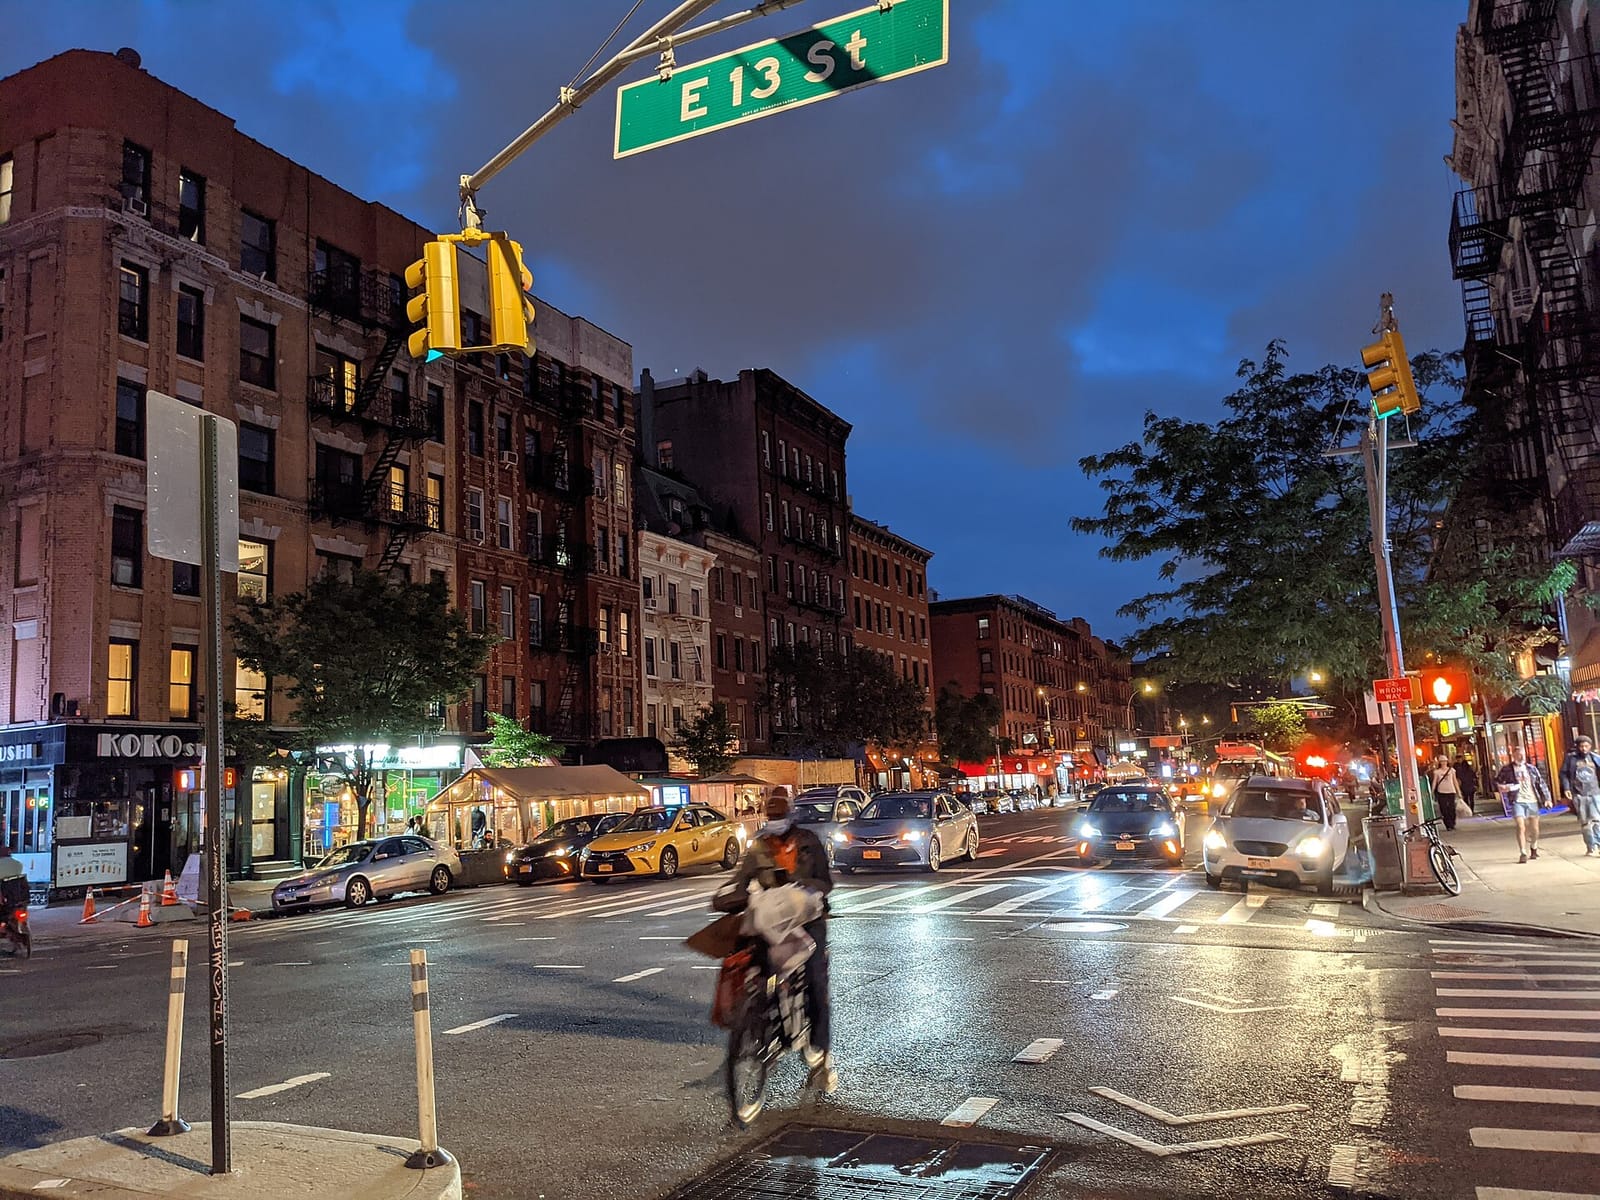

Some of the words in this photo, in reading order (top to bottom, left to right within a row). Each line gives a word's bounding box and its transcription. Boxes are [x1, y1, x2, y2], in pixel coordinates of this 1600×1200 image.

[681, 76, 709, 122] E
[729, 57, 781, 107] 13
[803, 29, 867, 83] St
[97, 733, 183, 758] KOKO
